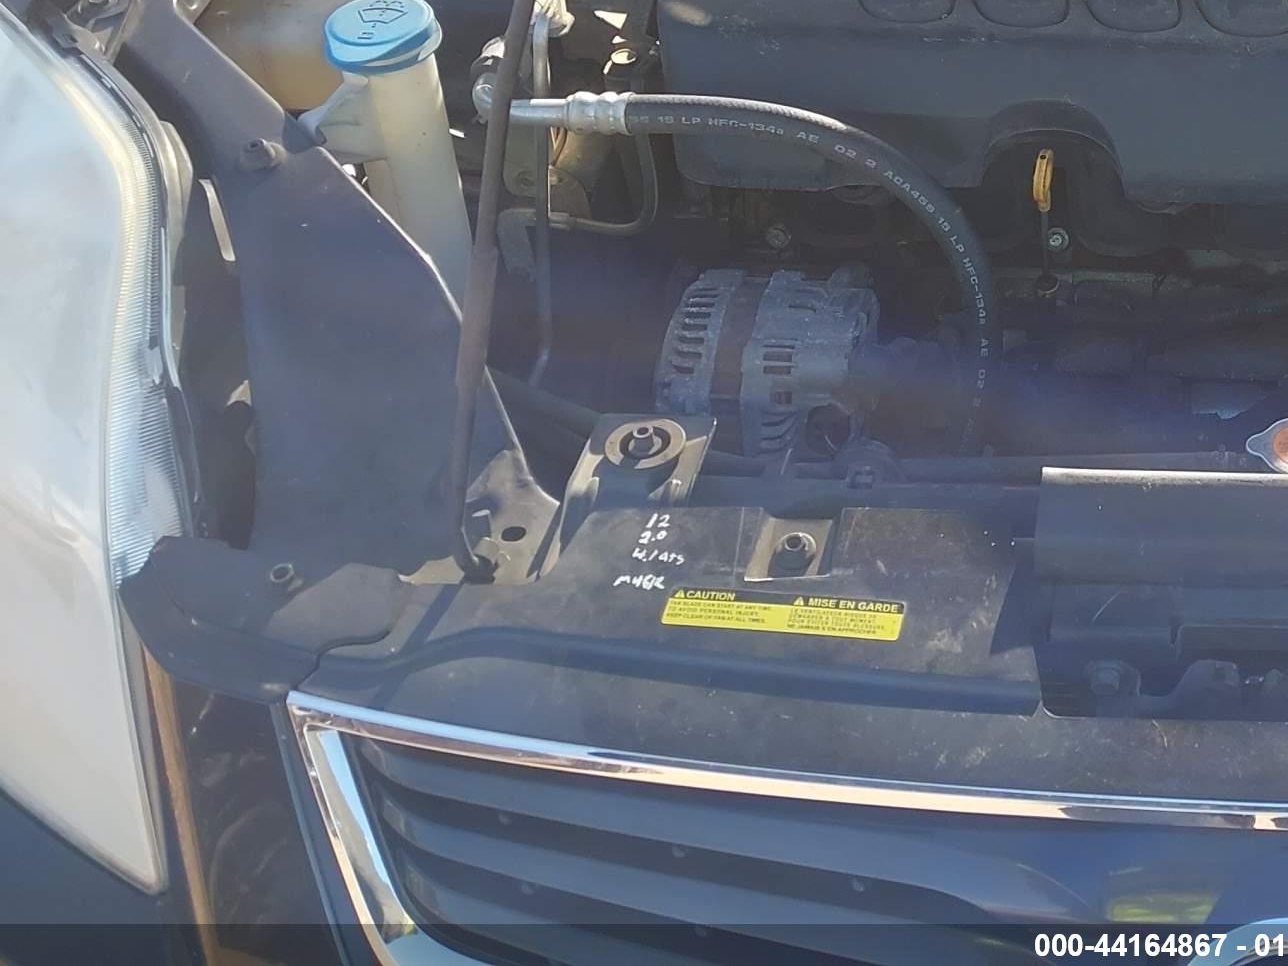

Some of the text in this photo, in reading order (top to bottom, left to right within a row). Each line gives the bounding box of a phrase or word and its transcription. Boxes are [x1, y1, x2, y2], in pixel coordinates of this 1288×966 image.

[681, 115, 701, 126] LP
[950, 235, 965, 253] LP
[645, 513, 671, 529] 12
[638, 530, 668, 545] 2.0
[686, 590, 736, 601] CAUTION
[808, 597, 838, 608] MISE
[839, 601, 856, 610] EN
[858, 602, 898, 613] GARDE
